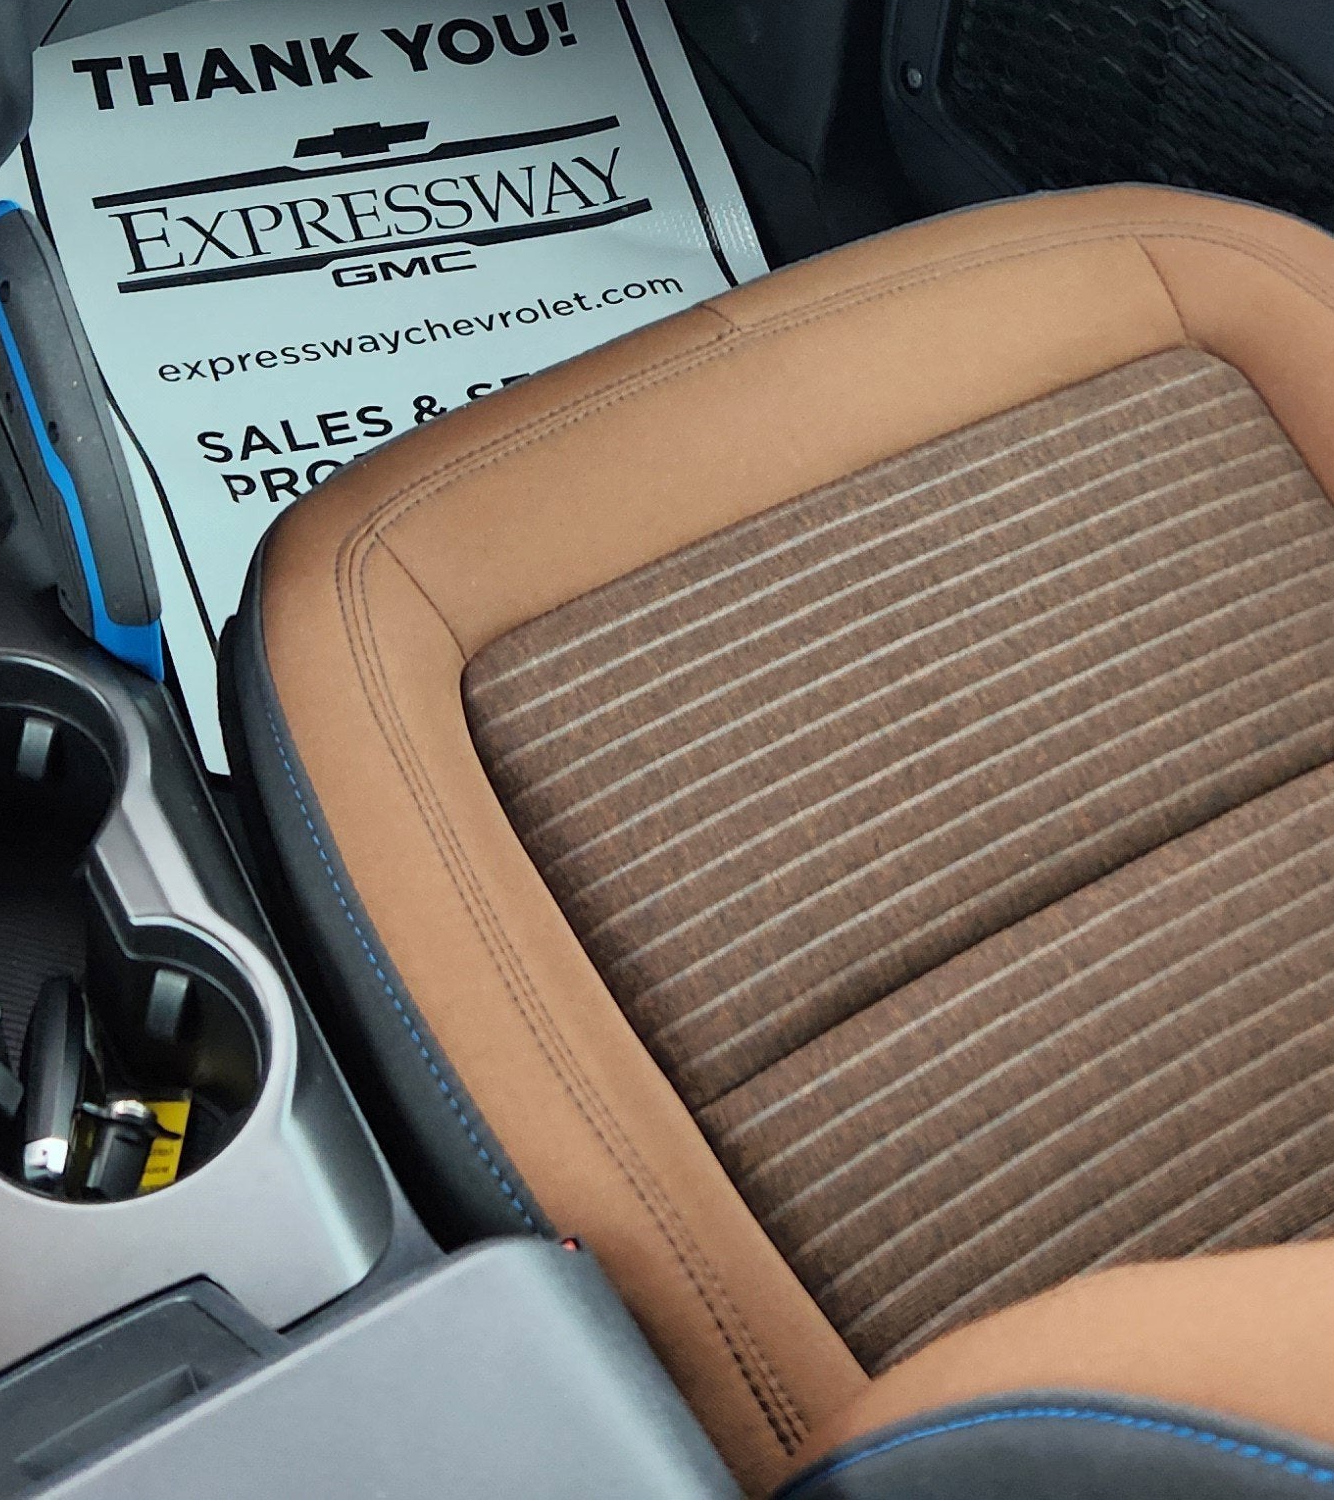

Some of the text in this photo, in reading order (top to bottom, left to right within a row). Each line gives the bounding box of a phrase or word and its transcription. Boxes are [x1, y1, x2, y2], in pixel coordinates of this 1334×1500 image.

[71, 0, 579, 112] THANK YOU!
[108, 147, 632, 276] EXPRESSWAY
[332, 249, 478, 289] GMC
[157, 271, 685, 384] expresswaychevrolet.com
[196, 394, 448, 464] SALES &
